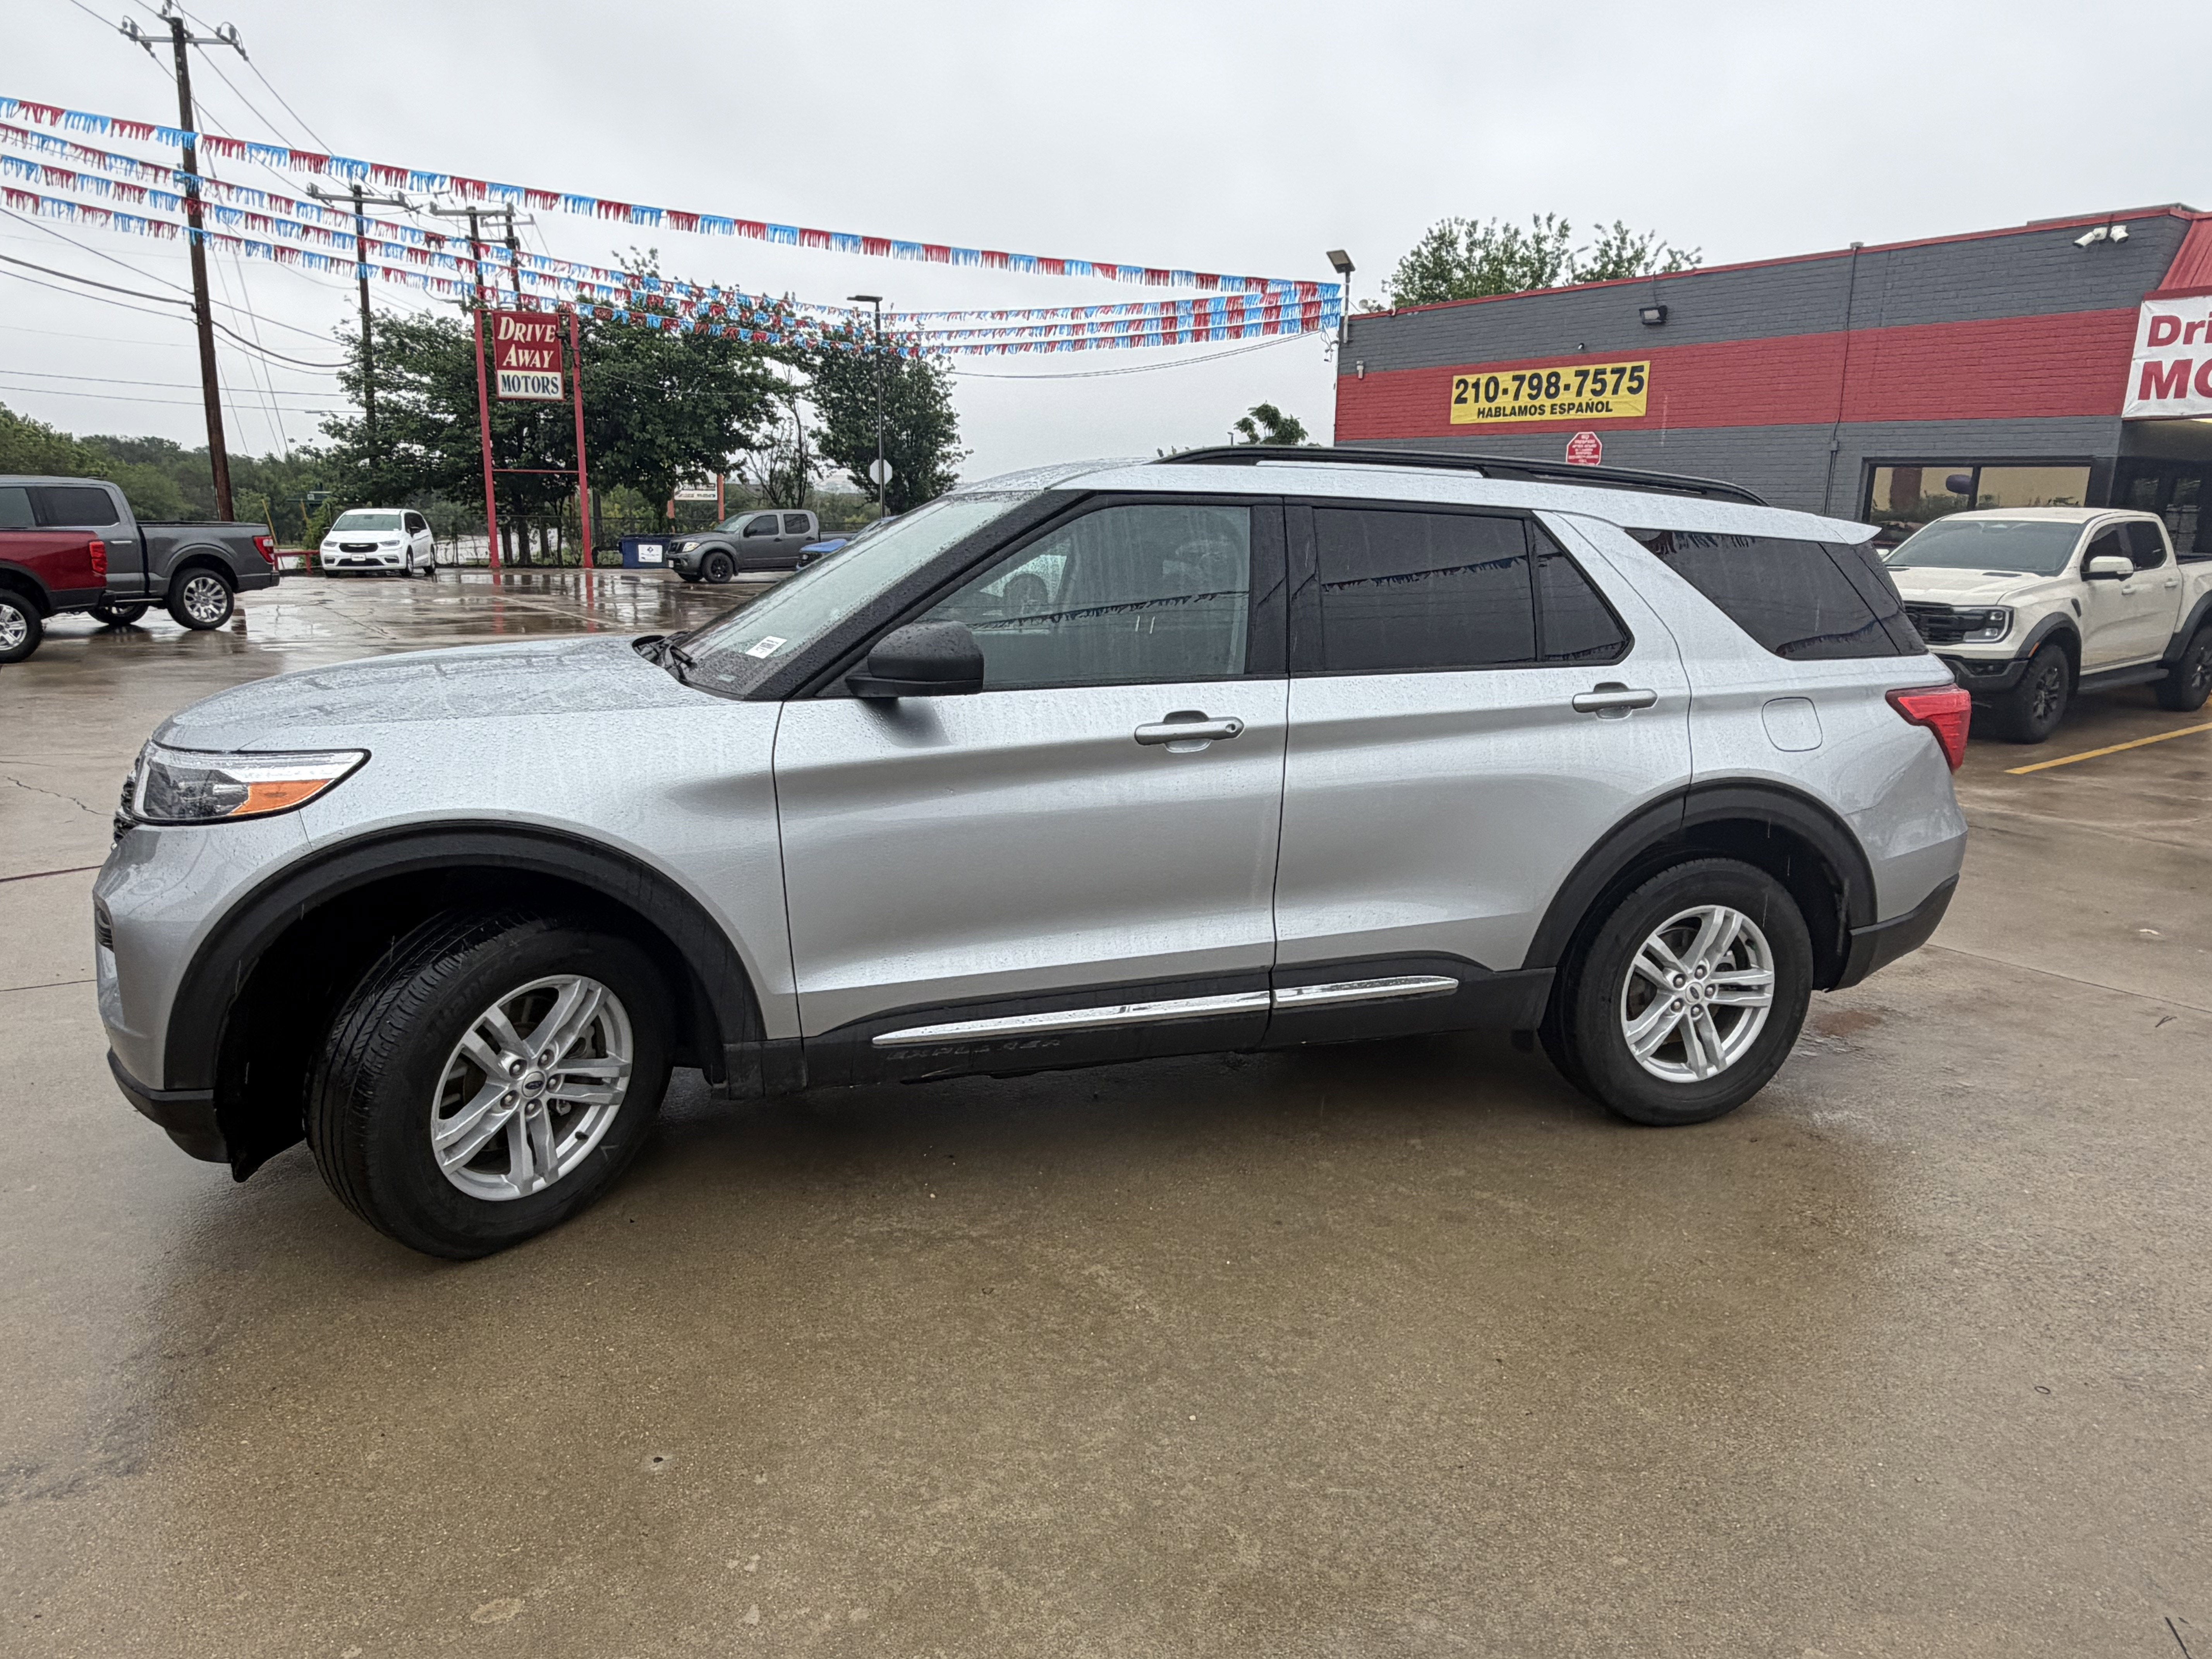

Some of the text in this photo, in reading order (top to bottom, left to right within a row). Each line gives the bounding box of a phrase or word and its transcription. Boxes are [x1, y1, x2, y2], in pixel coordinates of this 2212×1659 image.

[497, 316, 556, 343] DRIVE
[2147, 311, 2212, 347] Dri
[502, 343, 555, 368] AWAY
[501, 374, 559, 395] MOTORS
[1454, 365, 1645, 404] 210-798-7575
[1477, 398, 1613, 419] HABLAMOS ESPAÑOL
